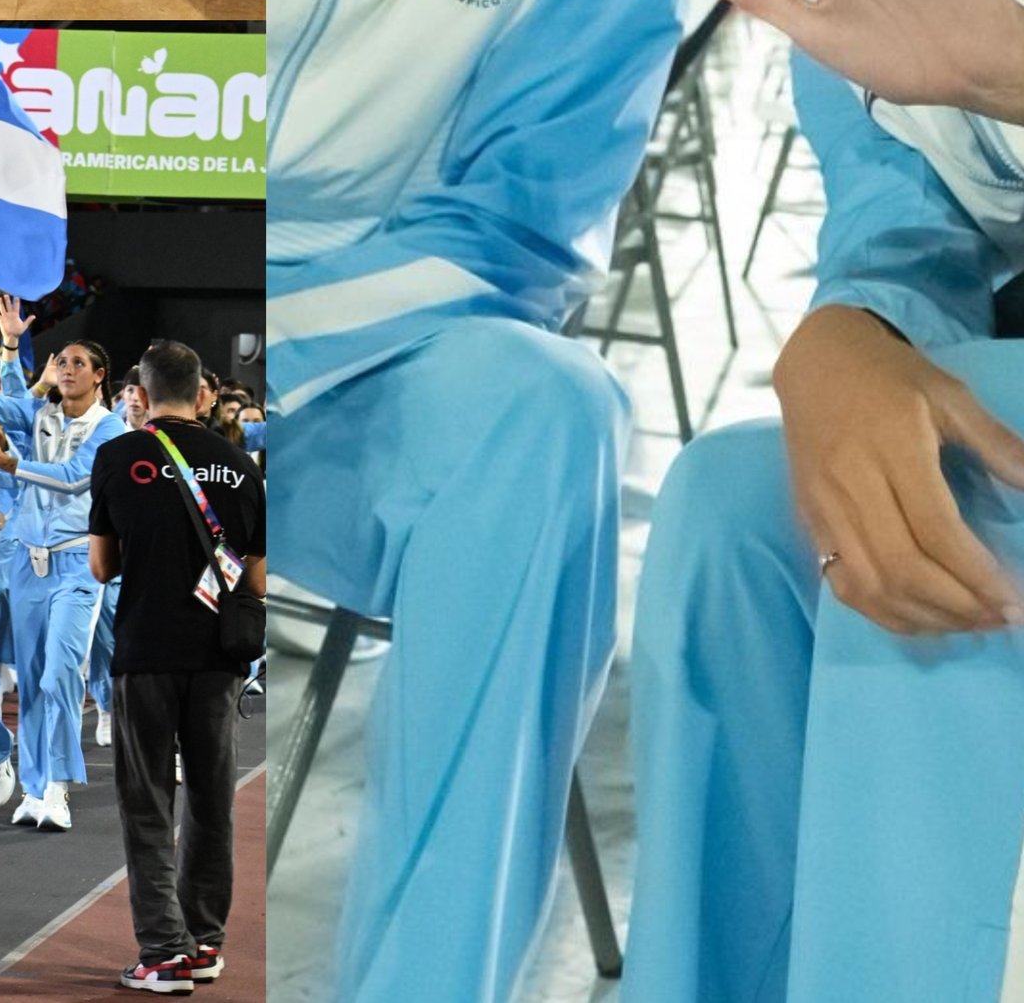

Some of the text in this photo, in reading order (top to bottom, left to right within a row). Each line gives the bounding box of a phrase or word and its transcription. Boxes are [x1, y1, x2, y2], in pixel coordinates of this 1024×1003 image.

[61, 152, 200, 172] RAMERICANOS
[203, 156, 229, 172] DE
[231, 157, 257, 173] LA
